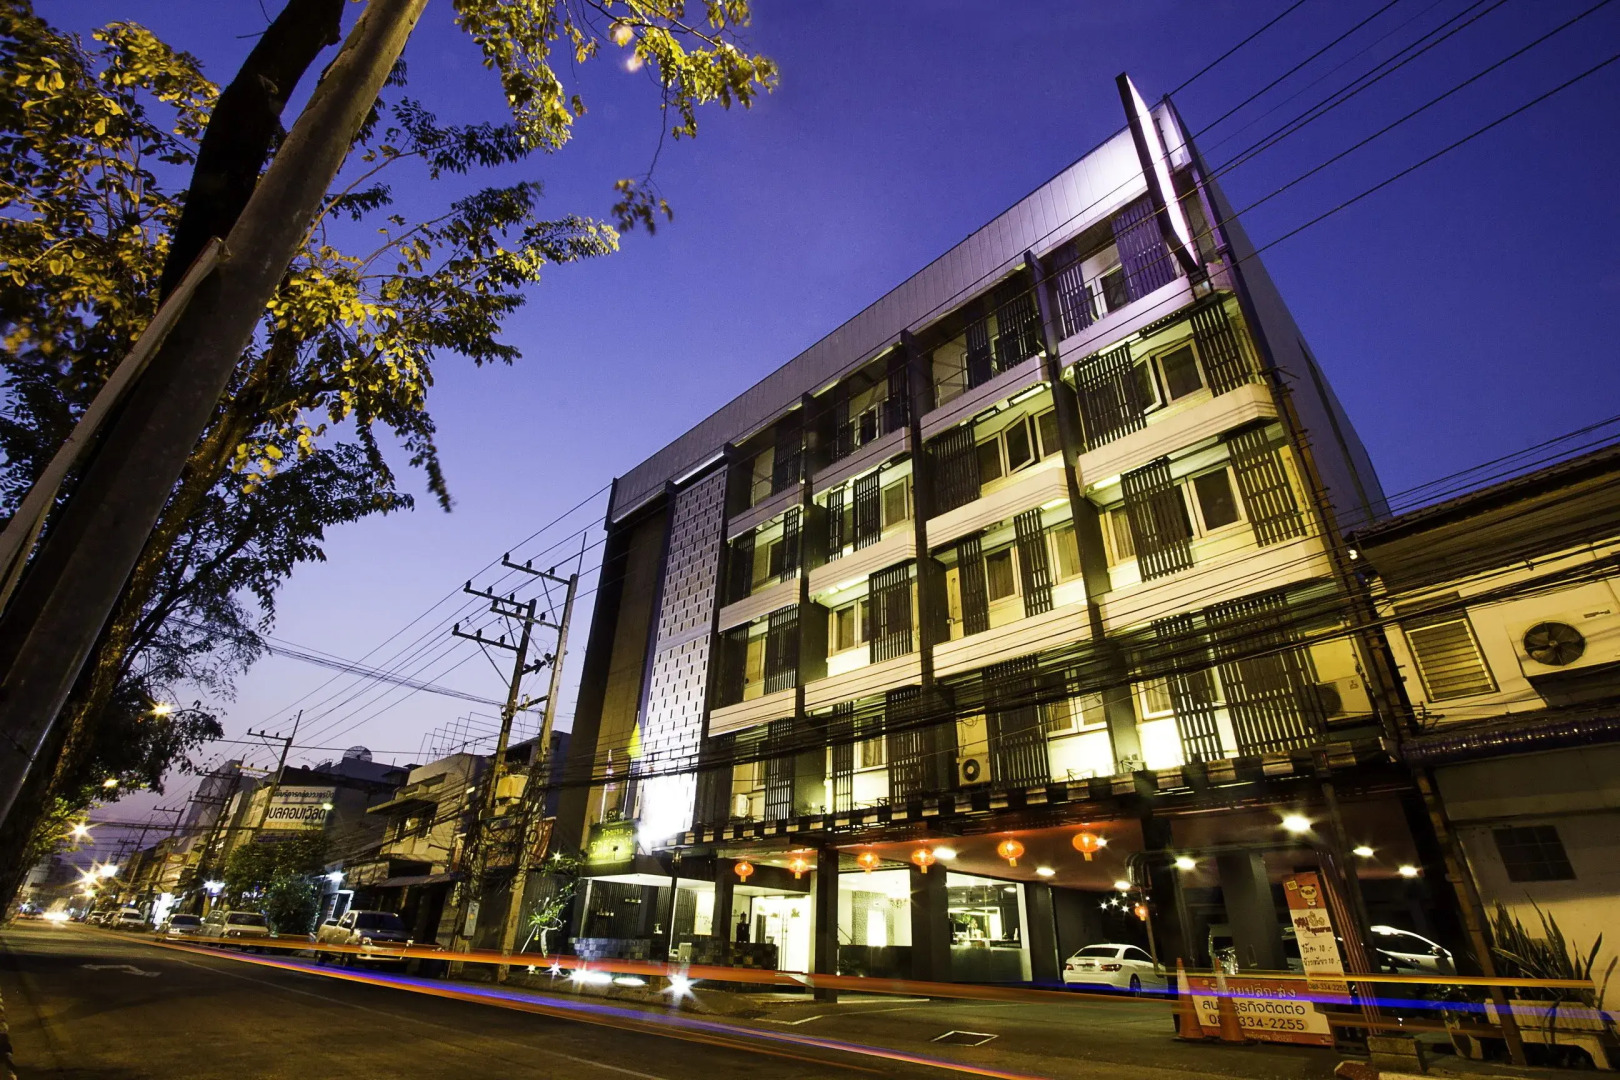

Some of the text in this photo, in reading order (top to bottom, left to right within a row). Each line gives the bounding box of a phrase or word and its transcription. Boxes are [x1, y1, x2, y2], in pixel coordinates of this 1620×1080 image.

[268, 806, 326, 820] บลคอมเวิลด
[1202, 1000, 1306, 1016] สนธุรกิจติดต่อ
[1209, 1014, 1305, 1031] 08334-2255
